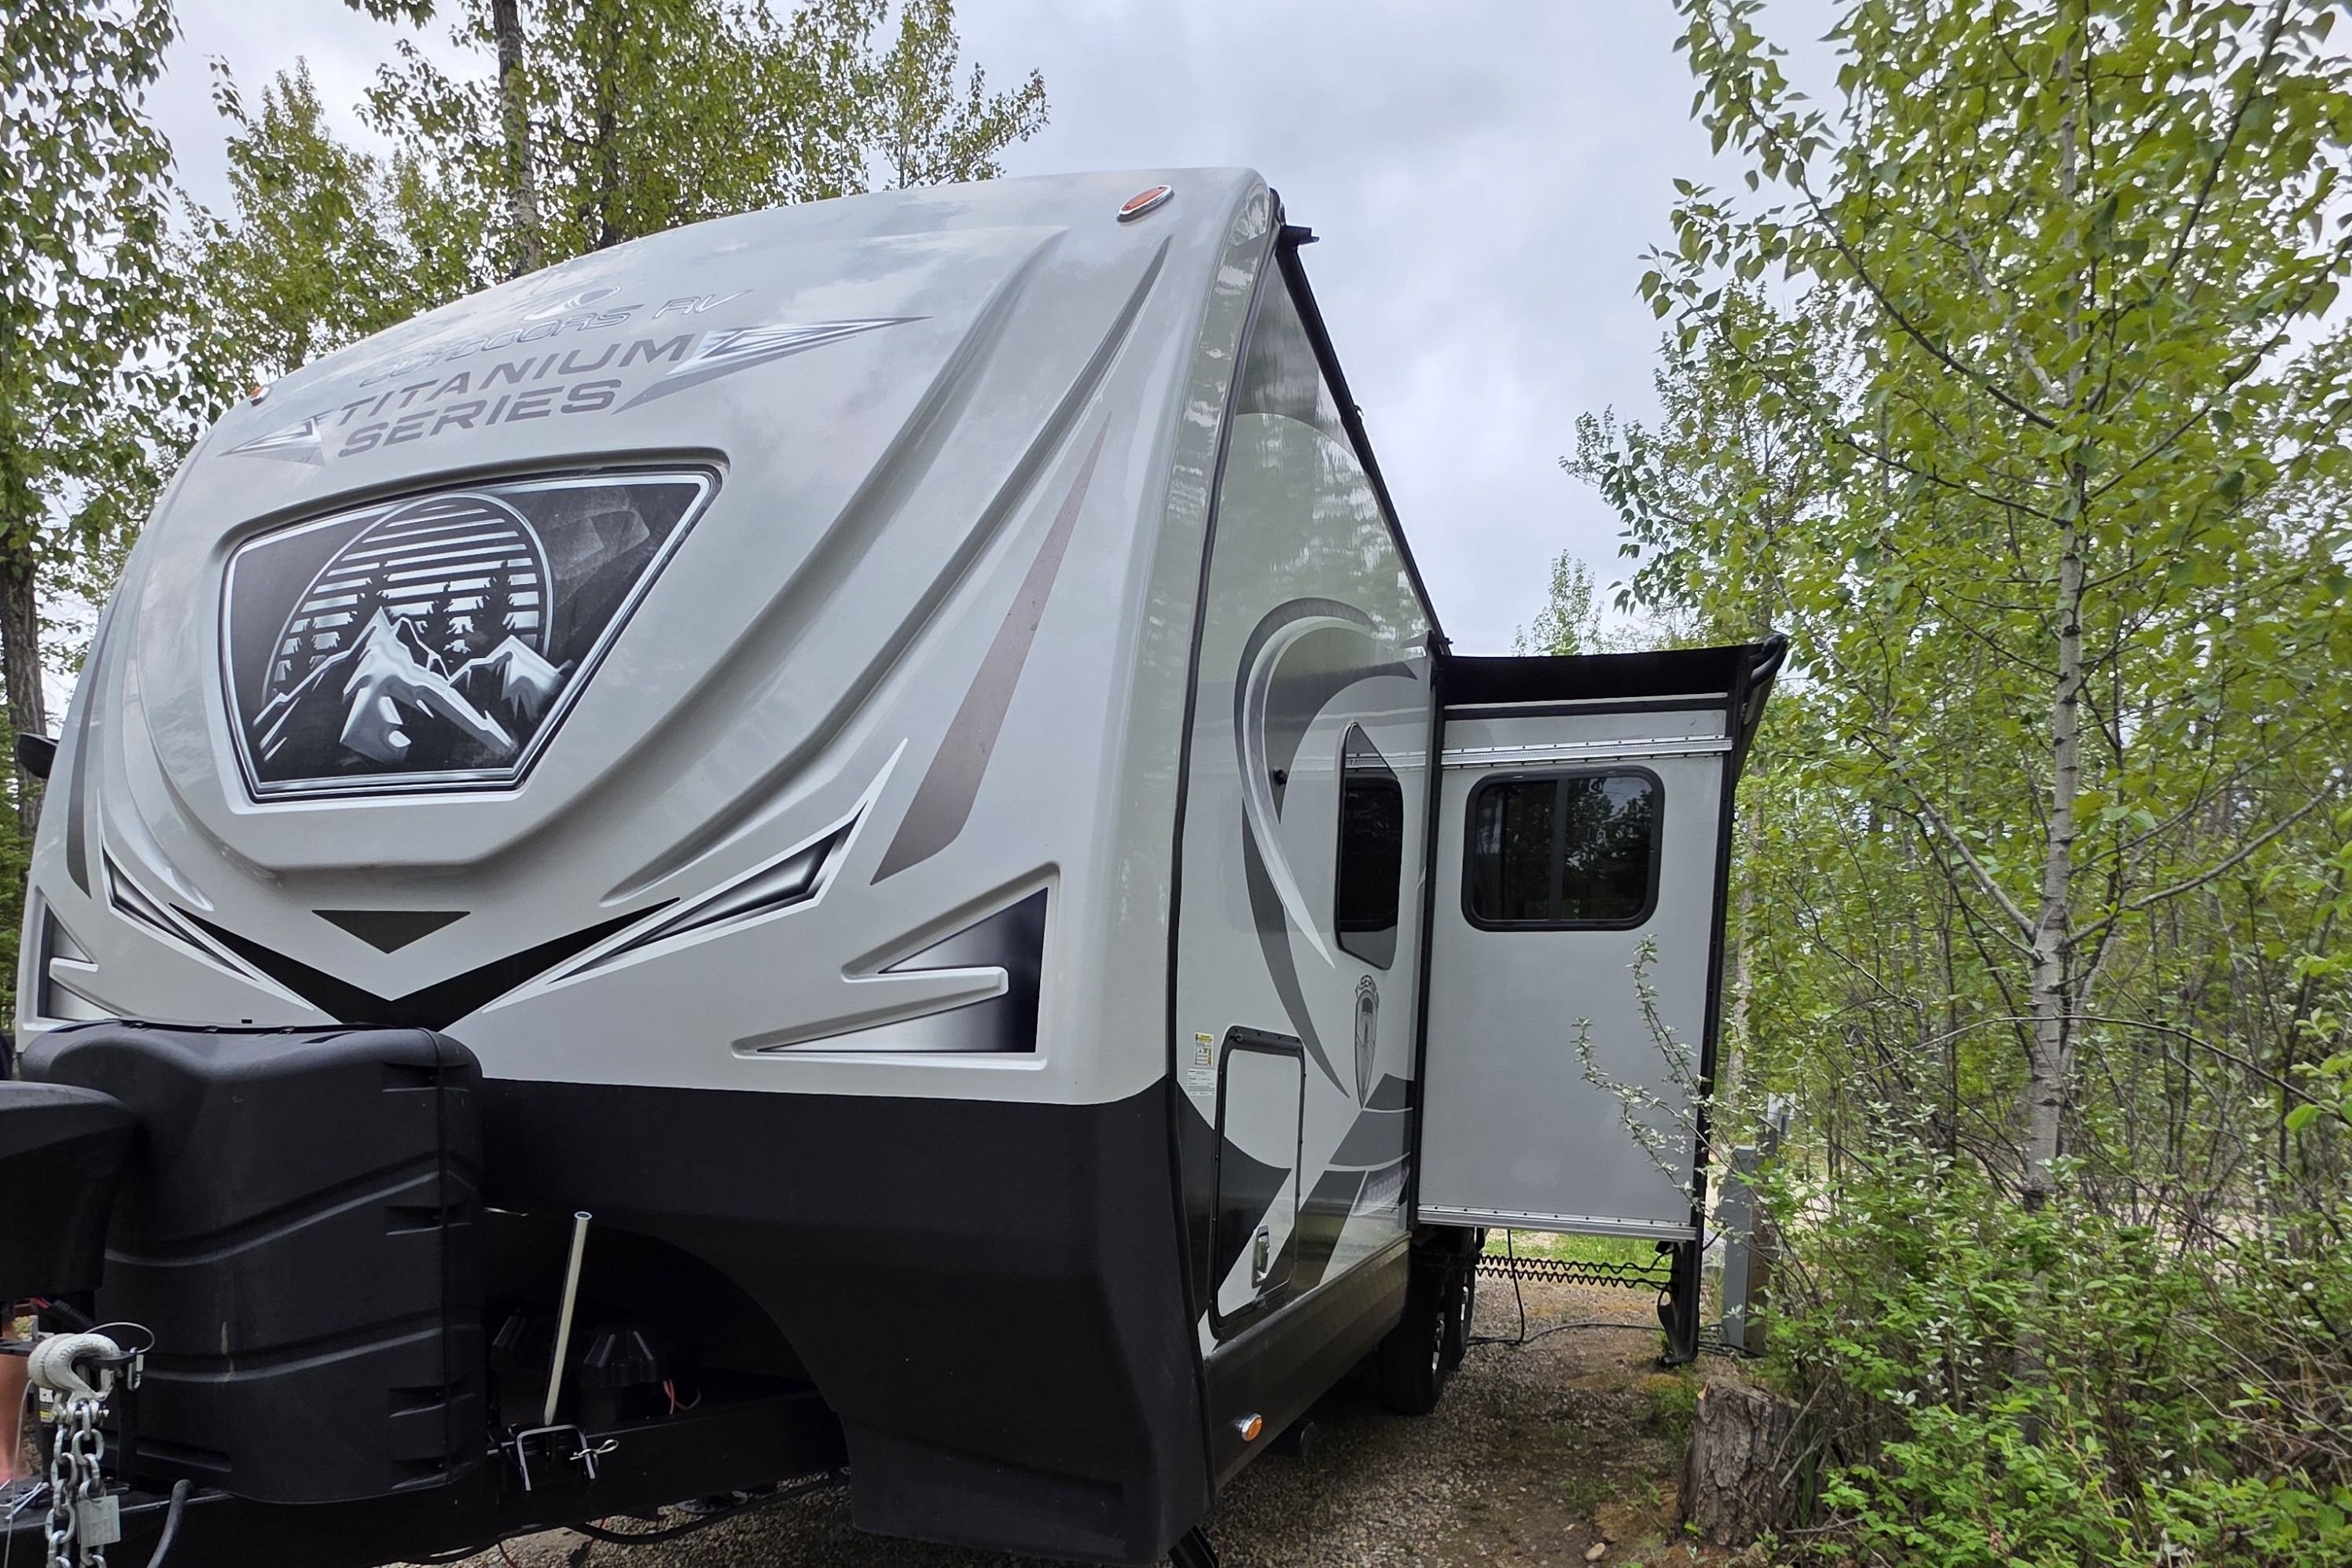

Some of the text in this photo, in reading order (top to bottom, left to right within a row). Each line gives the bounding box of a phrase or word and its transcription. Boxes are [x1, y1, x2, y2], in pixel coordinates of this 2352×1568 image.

[652, 288, 754, 321] RV
[337, 379, 623, 458] SERIES
[338, 332, 696, 427] TITANIUM
